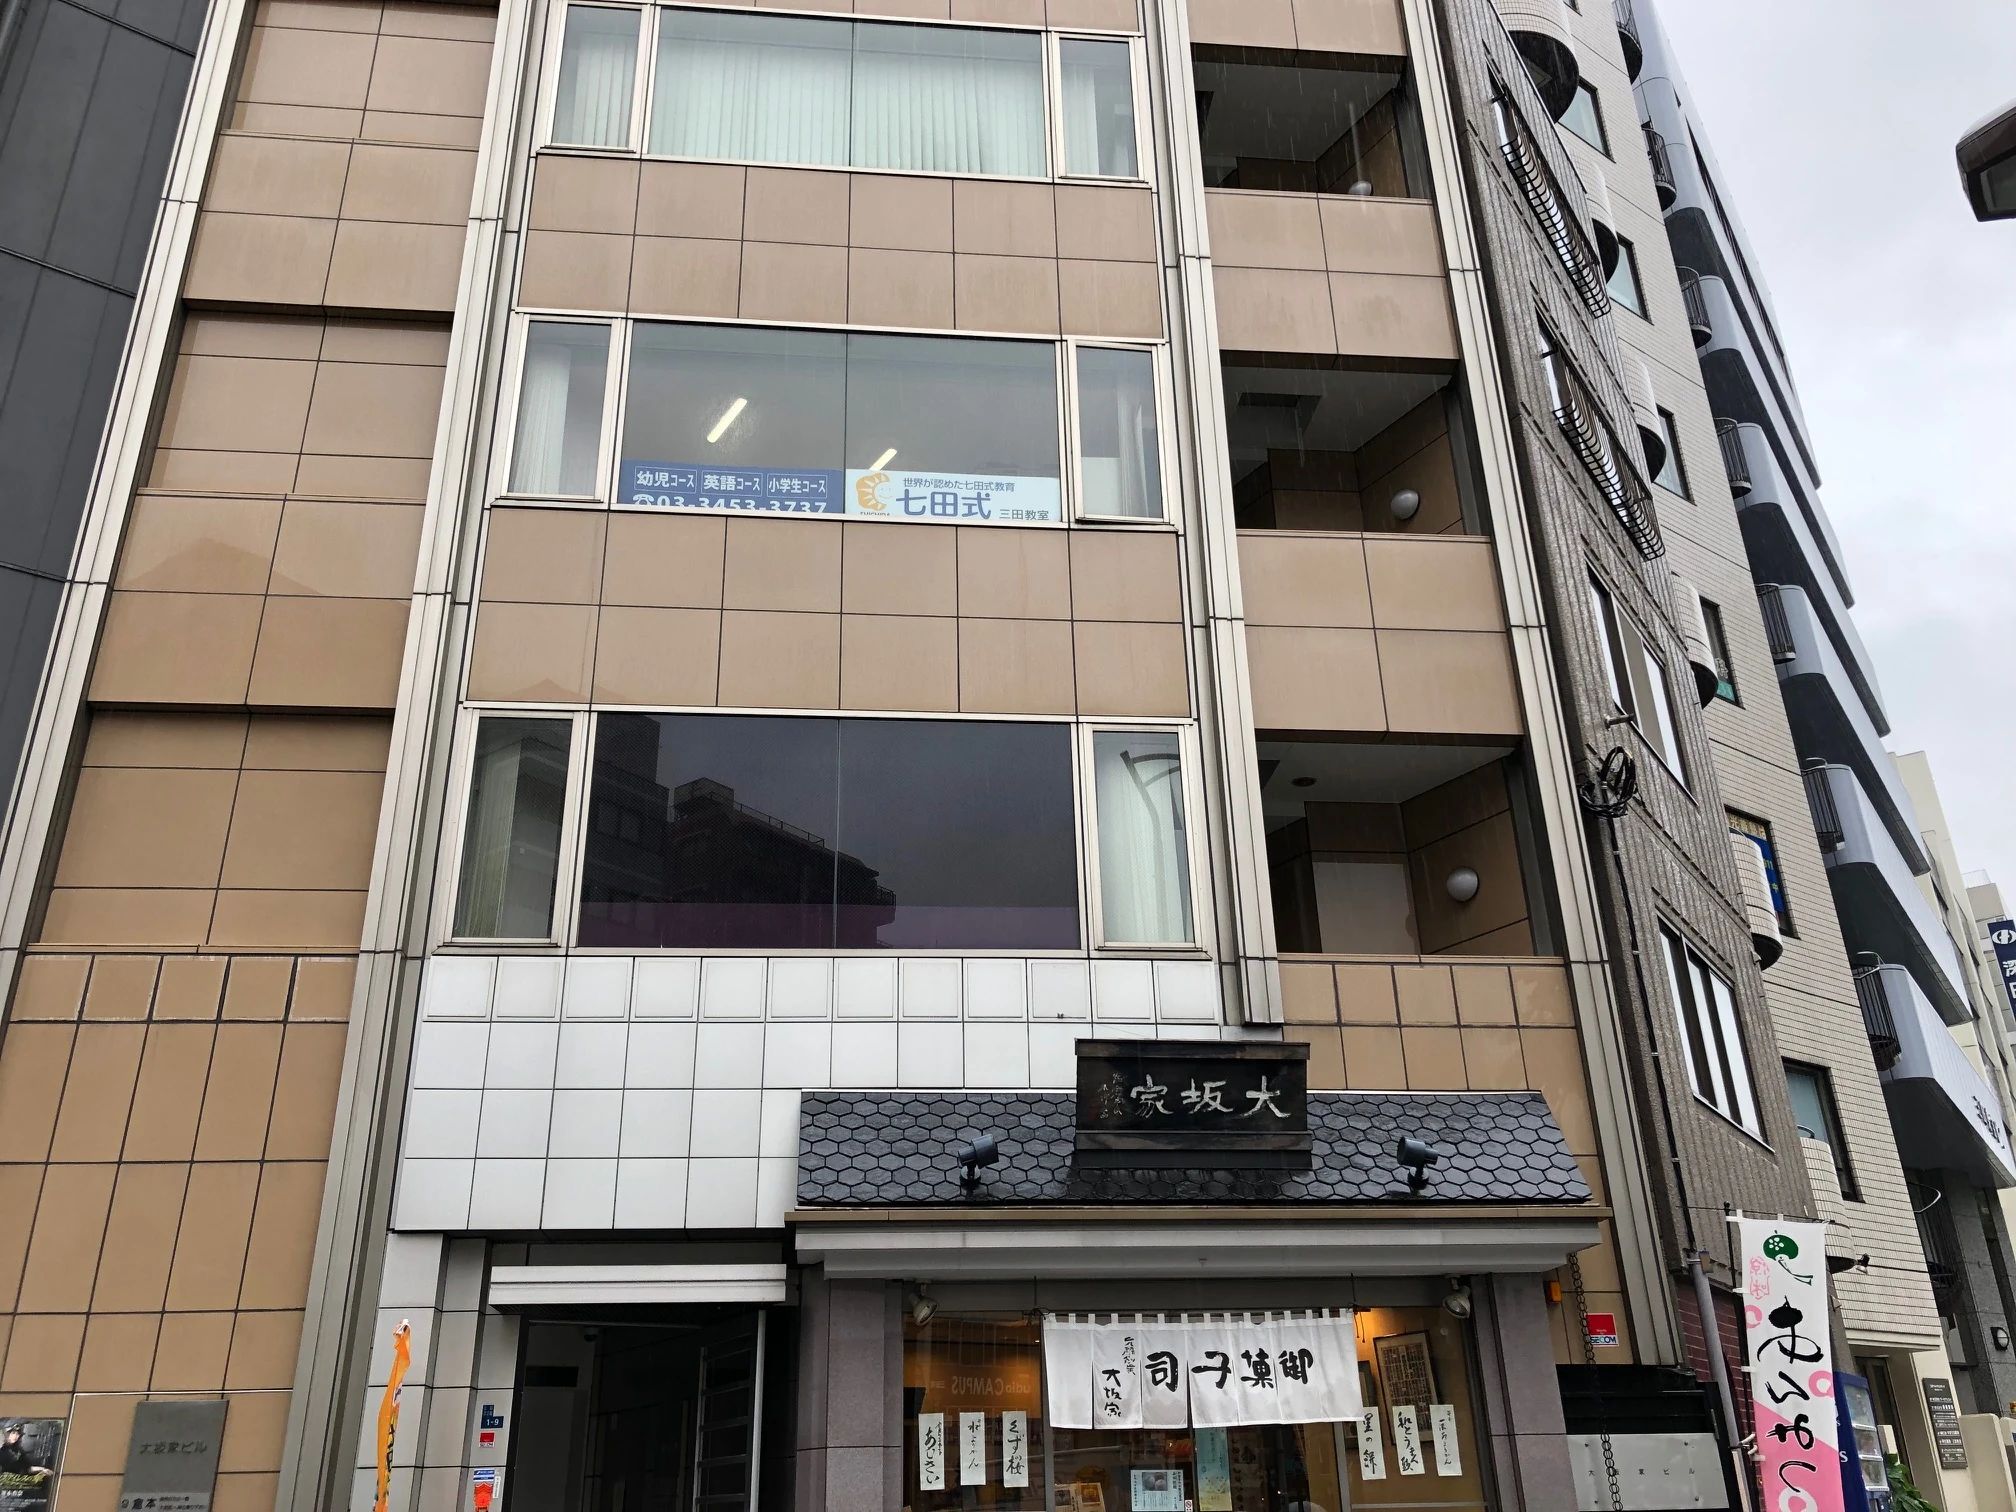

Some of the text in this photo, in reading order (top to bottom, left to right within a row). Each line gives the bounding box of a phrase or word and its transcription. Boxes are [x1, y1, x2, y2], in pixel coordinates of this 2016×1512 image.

[636, 470, 826, 494] 幼児コース 英語コース 小学生コース
[903, 477, 1016, 492] 世界が認めた七田式教育
[896, 488, 991, 519] 七田式
[999, 509, 1050, 521] 三田教室
[1590, 1336, 1617, 1344] SECOM
[486, 1418, 500, 1427] 1-9
[1005, 1419, 1025, 1475] くず桜
